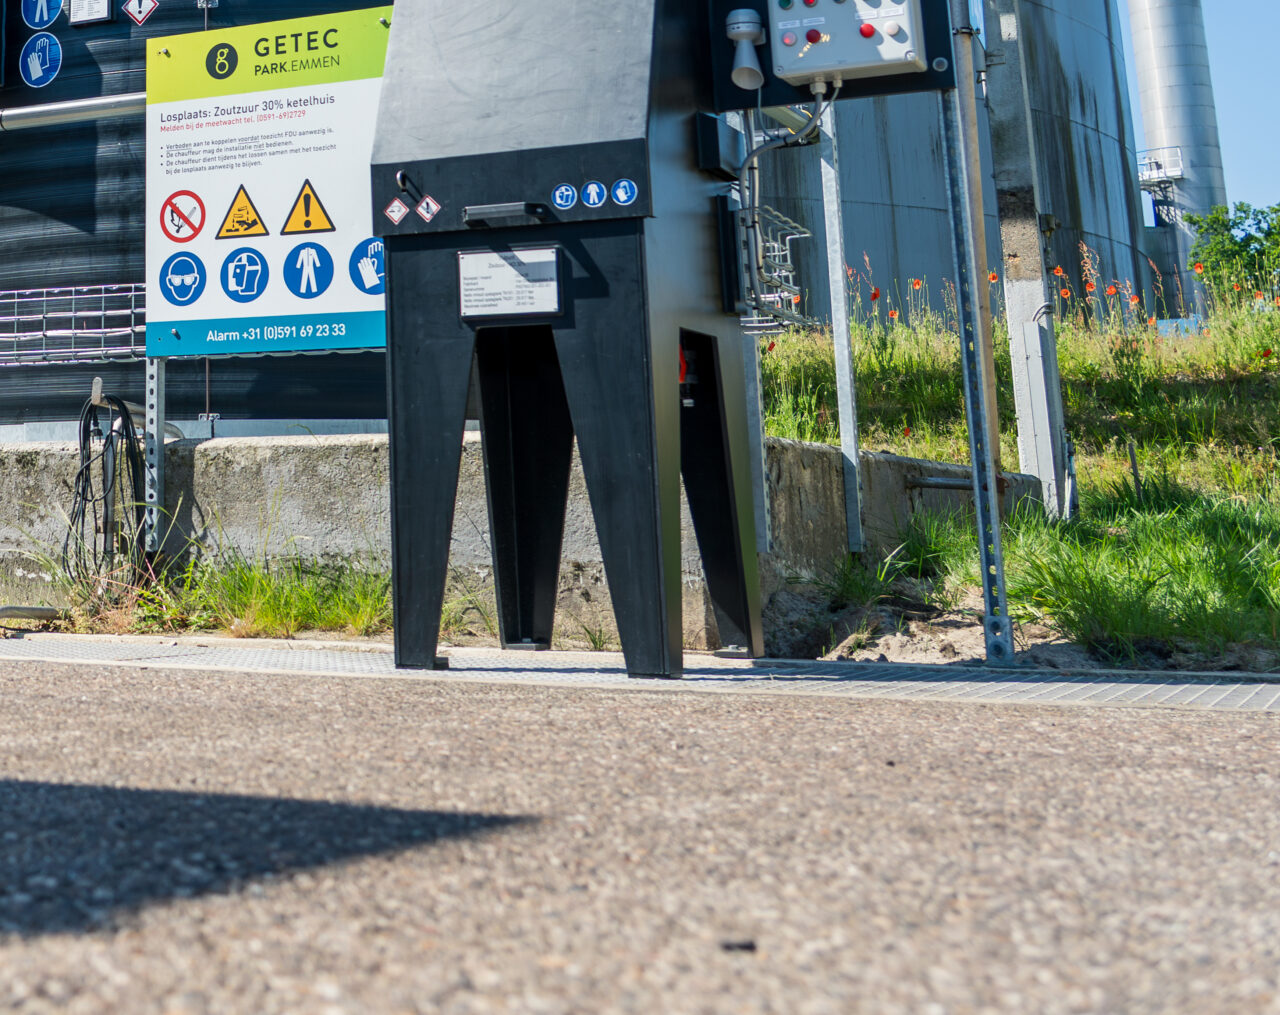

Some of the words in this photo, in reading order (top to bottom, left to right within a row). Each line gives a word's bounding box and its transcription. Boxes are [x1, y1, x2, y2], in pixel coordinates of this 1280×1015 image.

[254, 28, 339, 57] GETEC
[254, 55, 340, 76] PARK.EMMEN
[160, 110, 211, 123] Losplaats:
[214, 104, 259, 117] Zoutzuur
[262, 99, 284, 111] 30%
[286, 93, 335, 108] ketelhuis
[160, 123, 184, 133] Melden
[185, 122, 194, 131] bij
[195, 121, 204, 129] de
[205, 117, 242, 127] meetwacht
[243, 115, 255, 123] tel.
[256, 109, 306, 123] (0591-69)2729
[211, 137, 237, 145] koppelen
[238, 134, 260, 142] voordat
[260, 132, 283, 140] toezicht
[298, 128, 326, 136] aanwezig
[174, 149, 201, 157] chauffeur
[224, 143, 252, 152] installatie
[265, 140, 294, 148] bedienen.
[174, 158, 201, 166] chauffeur
[217, 154, 237, 162] tijdens
[312, 144, 337, 152] toezicht
[181, 166, 207, 174] losplaats
[242, 160, 262, 168] blijven.
[206, 329, 240, 342] Alarm
[242, 328, 260, 340] +31
[264, 325, 296, 340] (0)591
[300, 325, 313, 337] 69
[315, 324, 329, 337] 23
[331, 323, 346, 336] 33
